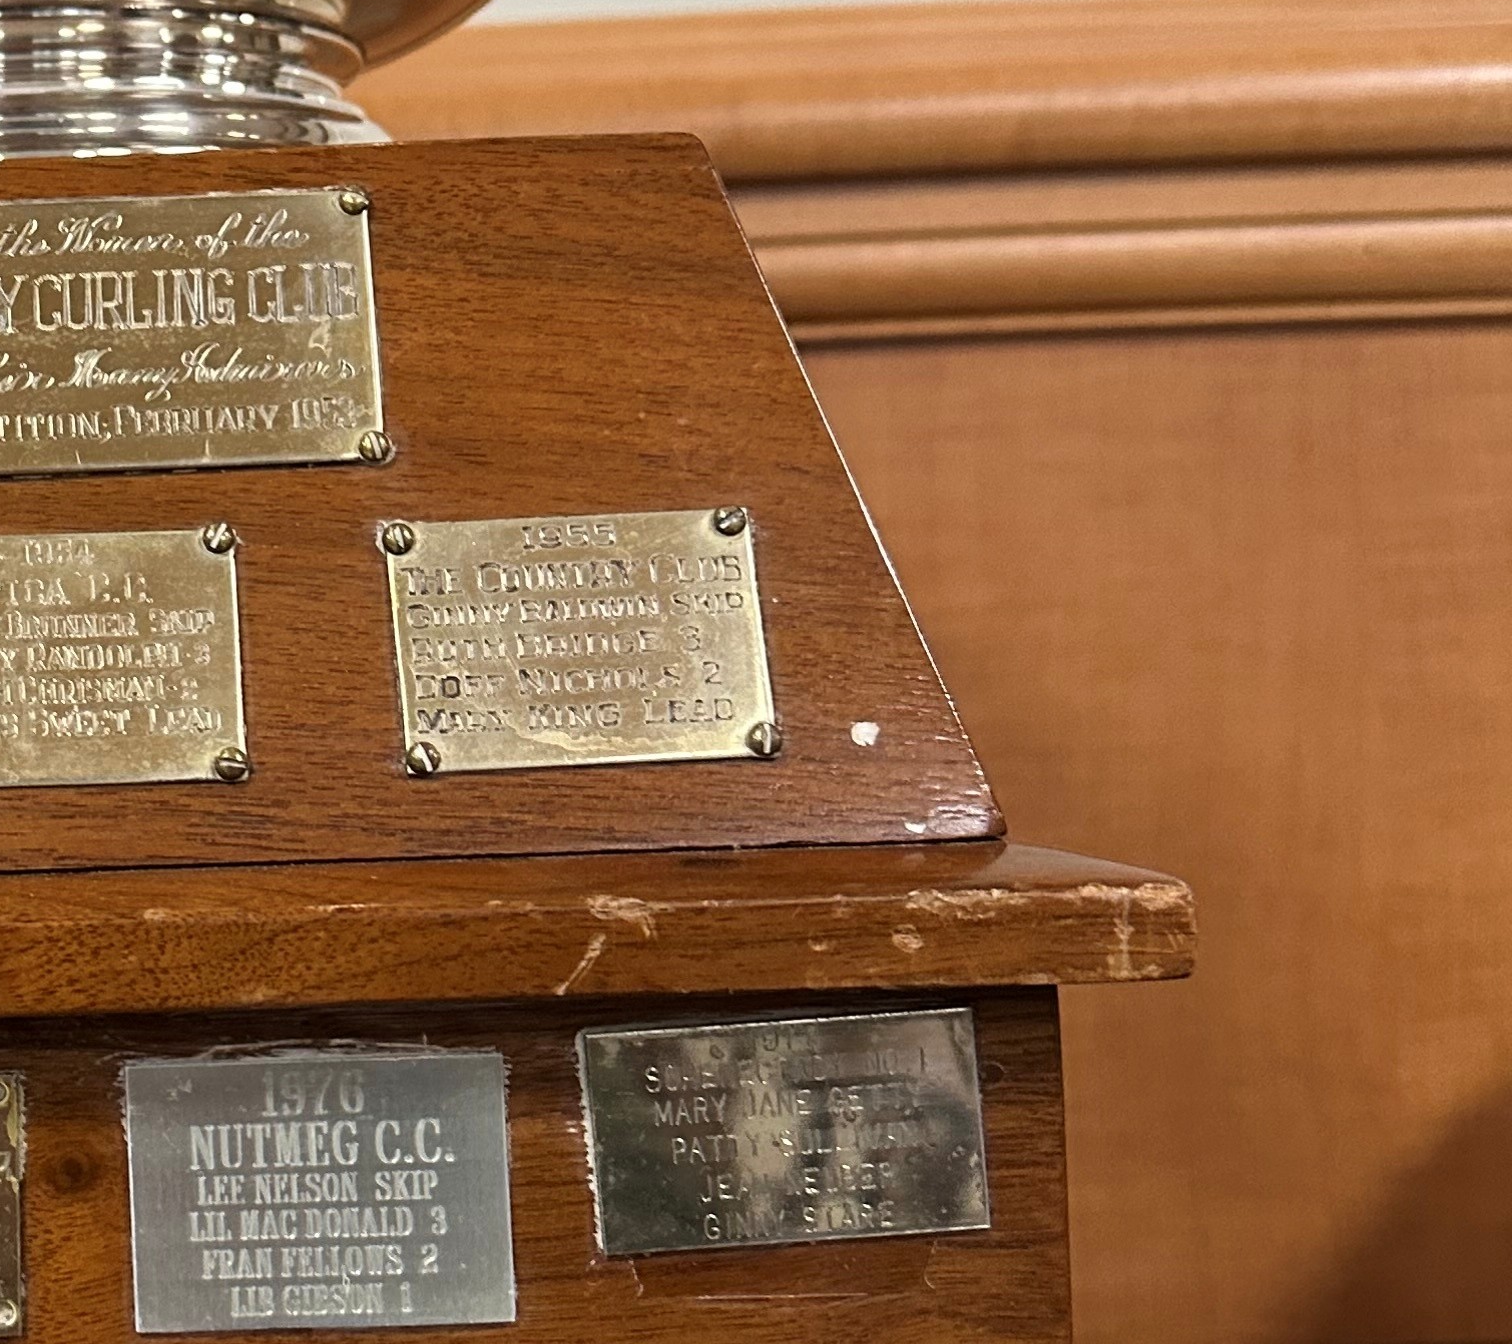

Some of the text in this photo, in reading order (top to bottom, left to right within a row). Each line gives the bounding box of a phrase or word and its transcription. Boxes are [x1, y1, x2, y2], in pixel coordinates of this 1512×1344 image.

[195, 210, 238, 259] of
[244, 210, 311, 249] the
[33, 268, 236, 331] CURLING
[247, 262, 358, 324] CLUB
[112, 404, 279, 435] FEBRUARY
[522, 524, 617, 550] 1955
[401, 554, 742, 595] THE COUNTRY CLUB
[407, 591, 743, 629] GINNY BALDWIN SKIP
[680, 625, 702, 653] 3
[519, 662, 722, 696] NICHOLS 2
[529, 698, 734, 729] KING LEAD
[261, 1069, 366, 1117] 1976
[654, 1098, 730, 1127] MARY
[190, 1118, 456, 1170] NUTMEG C.C.
[671, 1133, 762, 1164] PATTY
[197, 1170, 439, 1206] LEE NELSON SKIP
[190, 1205, 447, 1242] LIL MAC DONALD 3
[201, 1244, 439, 1280] FRAN FELLOWS 2
[231, 1283, 413, 1317] LIB GIBSON 1
